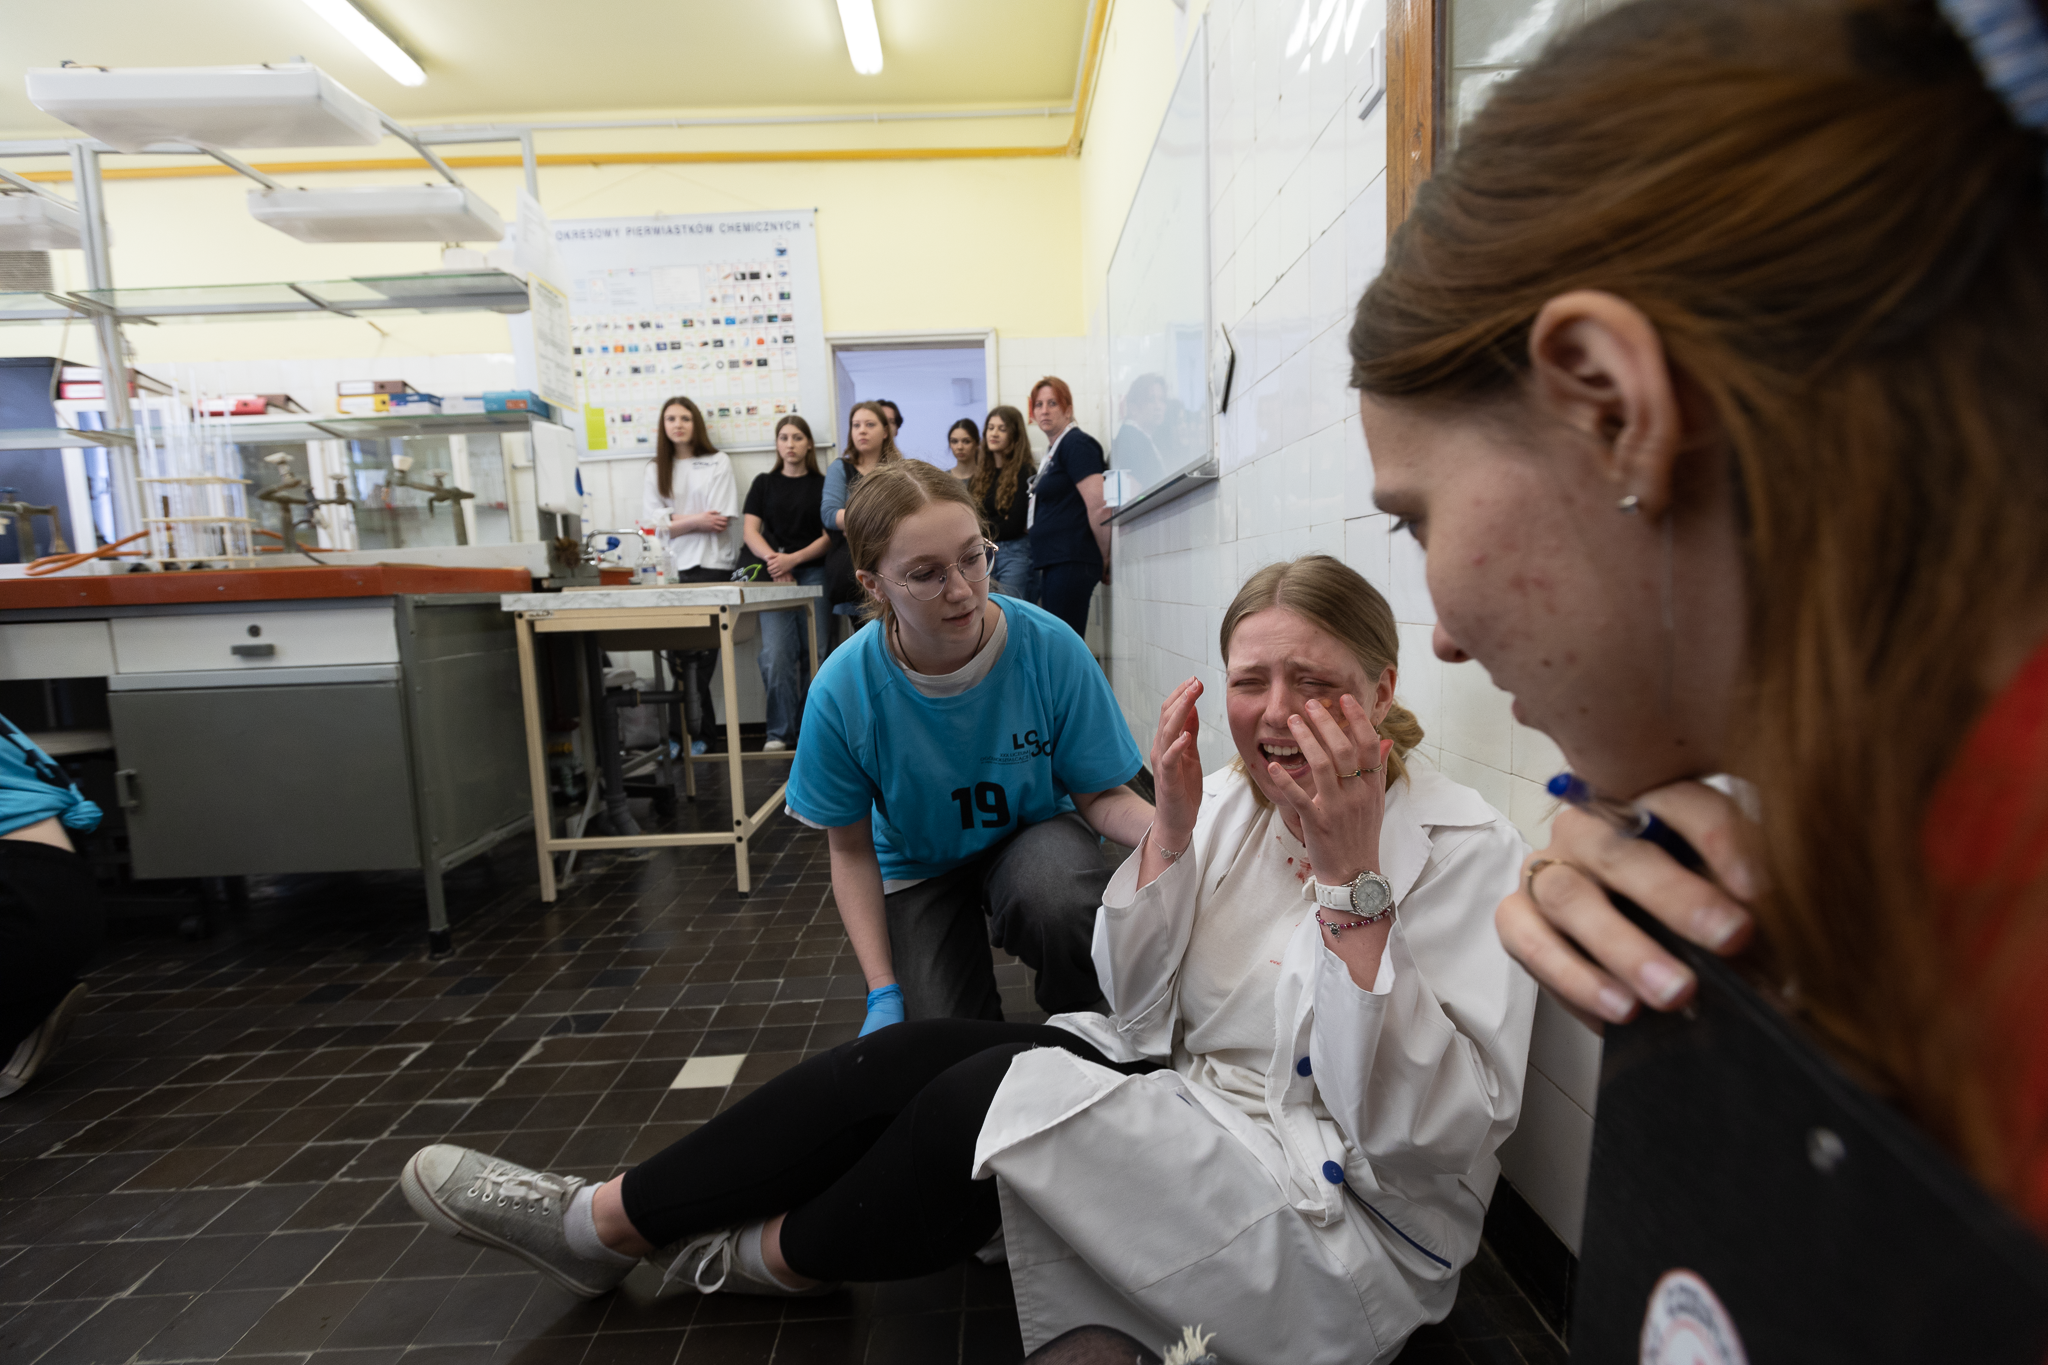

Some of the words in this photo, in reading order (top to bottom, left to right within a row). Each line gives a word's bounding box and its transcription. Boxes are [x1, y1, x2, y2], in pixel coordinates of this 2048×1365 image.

[555, 228, 620, 241] OKRESOWY
[625, 221, 713, 237] PIERWIASTKÓW
[719, 220, 801, 233] CHEMICZNYCH
[950, 781, 1011, 830] 19
